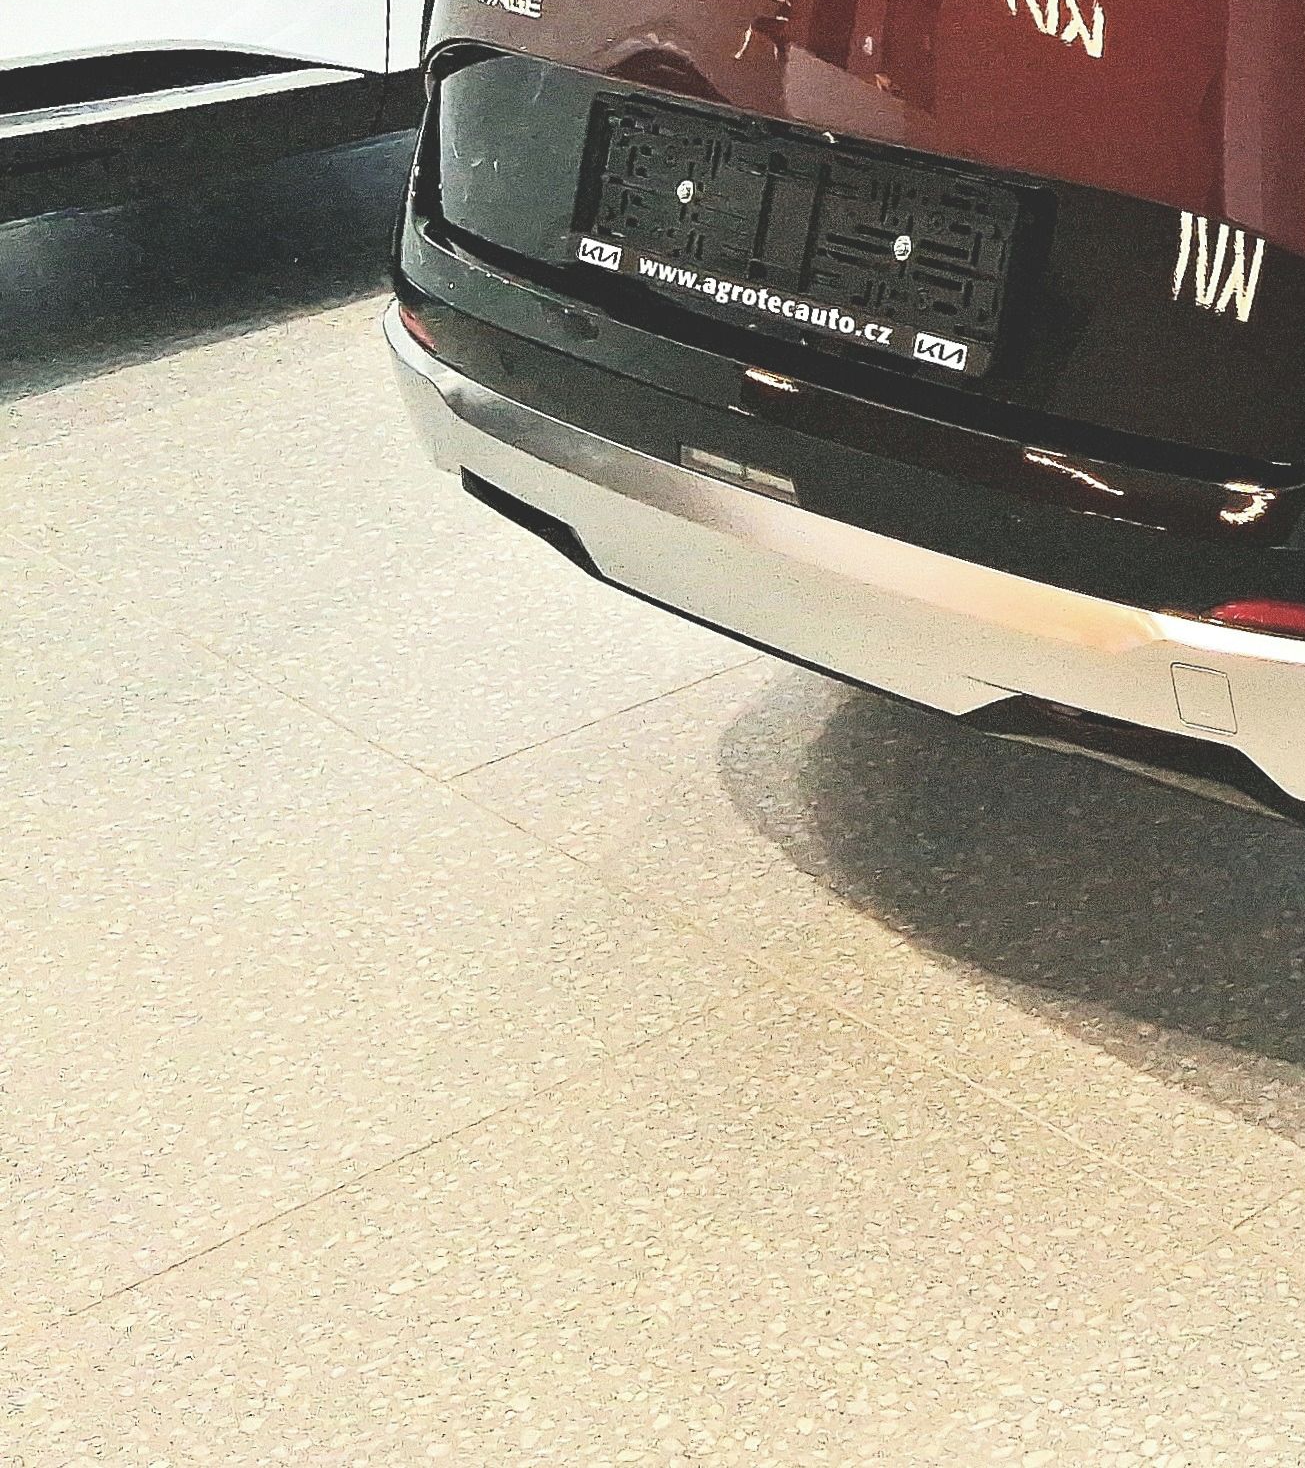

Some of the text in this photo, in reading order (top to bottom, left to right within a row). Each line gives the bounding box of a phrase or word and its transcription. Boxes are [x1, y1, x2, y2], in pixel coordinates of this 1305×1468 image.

[581, 241, 966, 368] KIA www.agrotecauto.cz KIA
